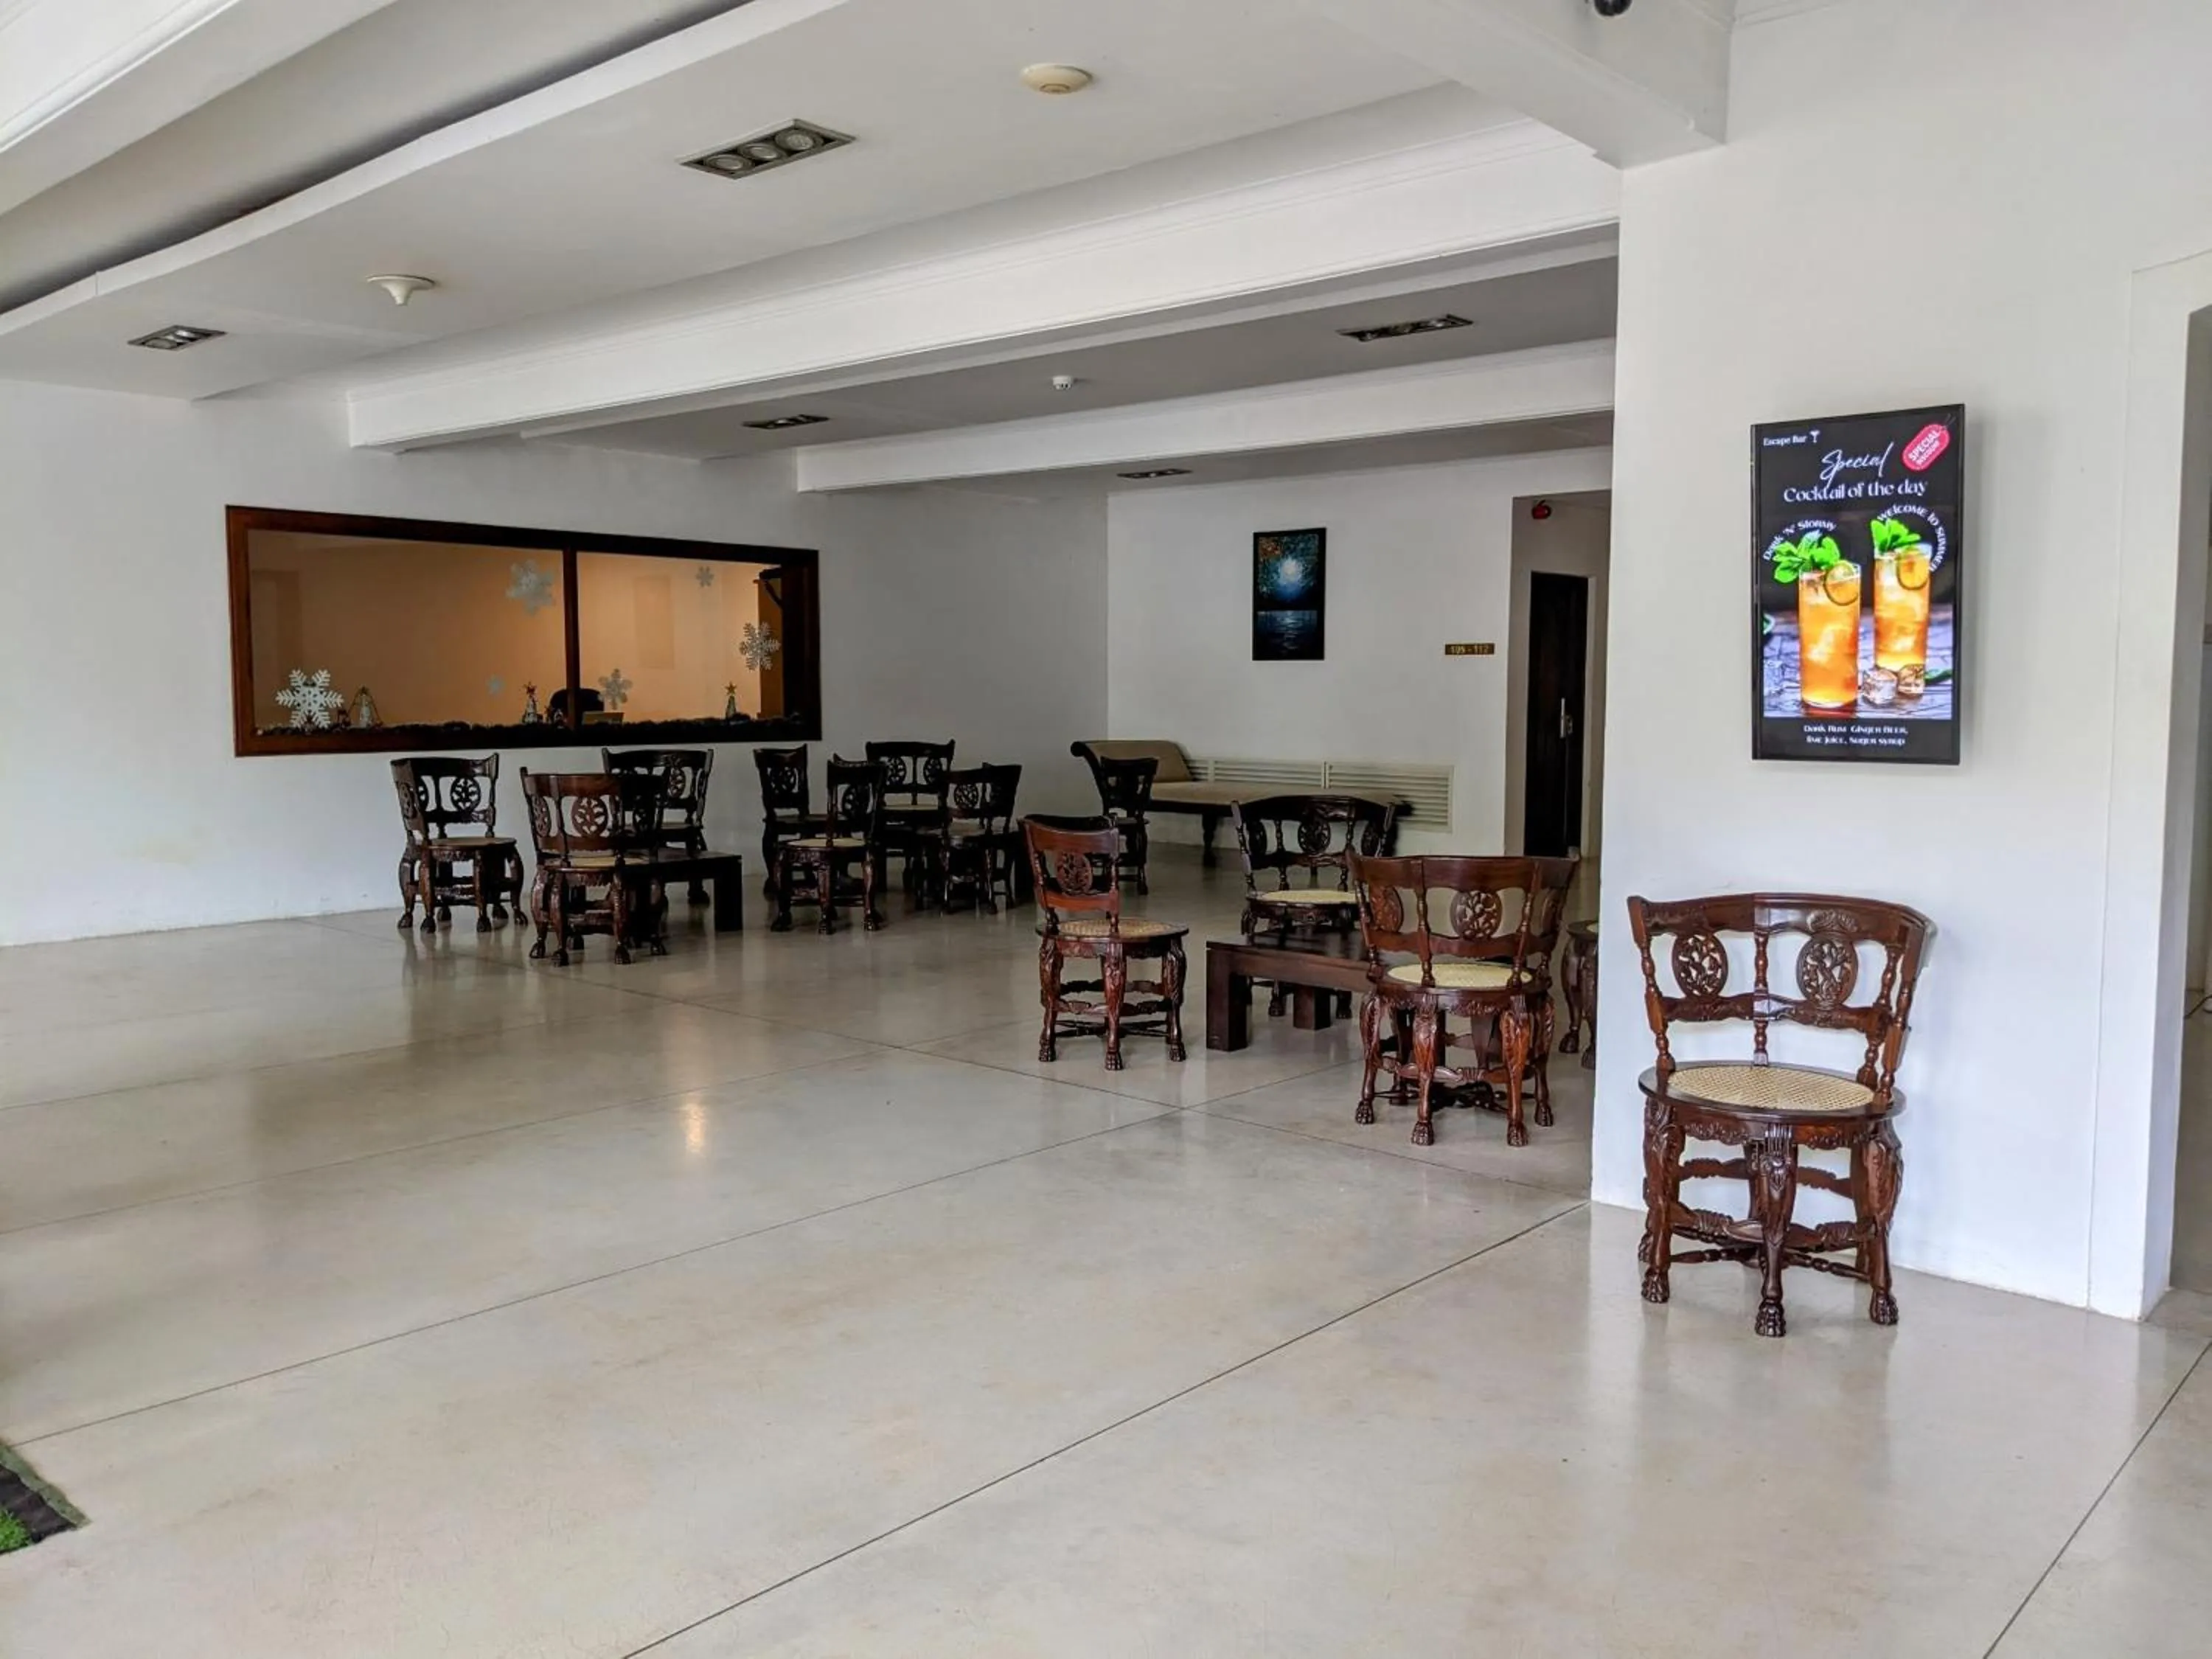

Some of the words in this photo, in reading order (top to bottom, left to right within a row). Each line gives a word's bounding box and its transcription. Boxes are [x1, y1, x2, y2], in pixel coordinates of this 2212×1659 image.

[1763, 437, 1791, 447] Escape
[1792, 434, 1807, 443] Bar
[1908, 430, 1941, 462] SPECIAL
[1820, 442, 1894, 488] Special
[1783, 484, 1846, 502] Cocktail
[1847, 482, 1865, 498] of
[1868, 481, 1894, 497] the
[1897, 479, 1927, 497] day
